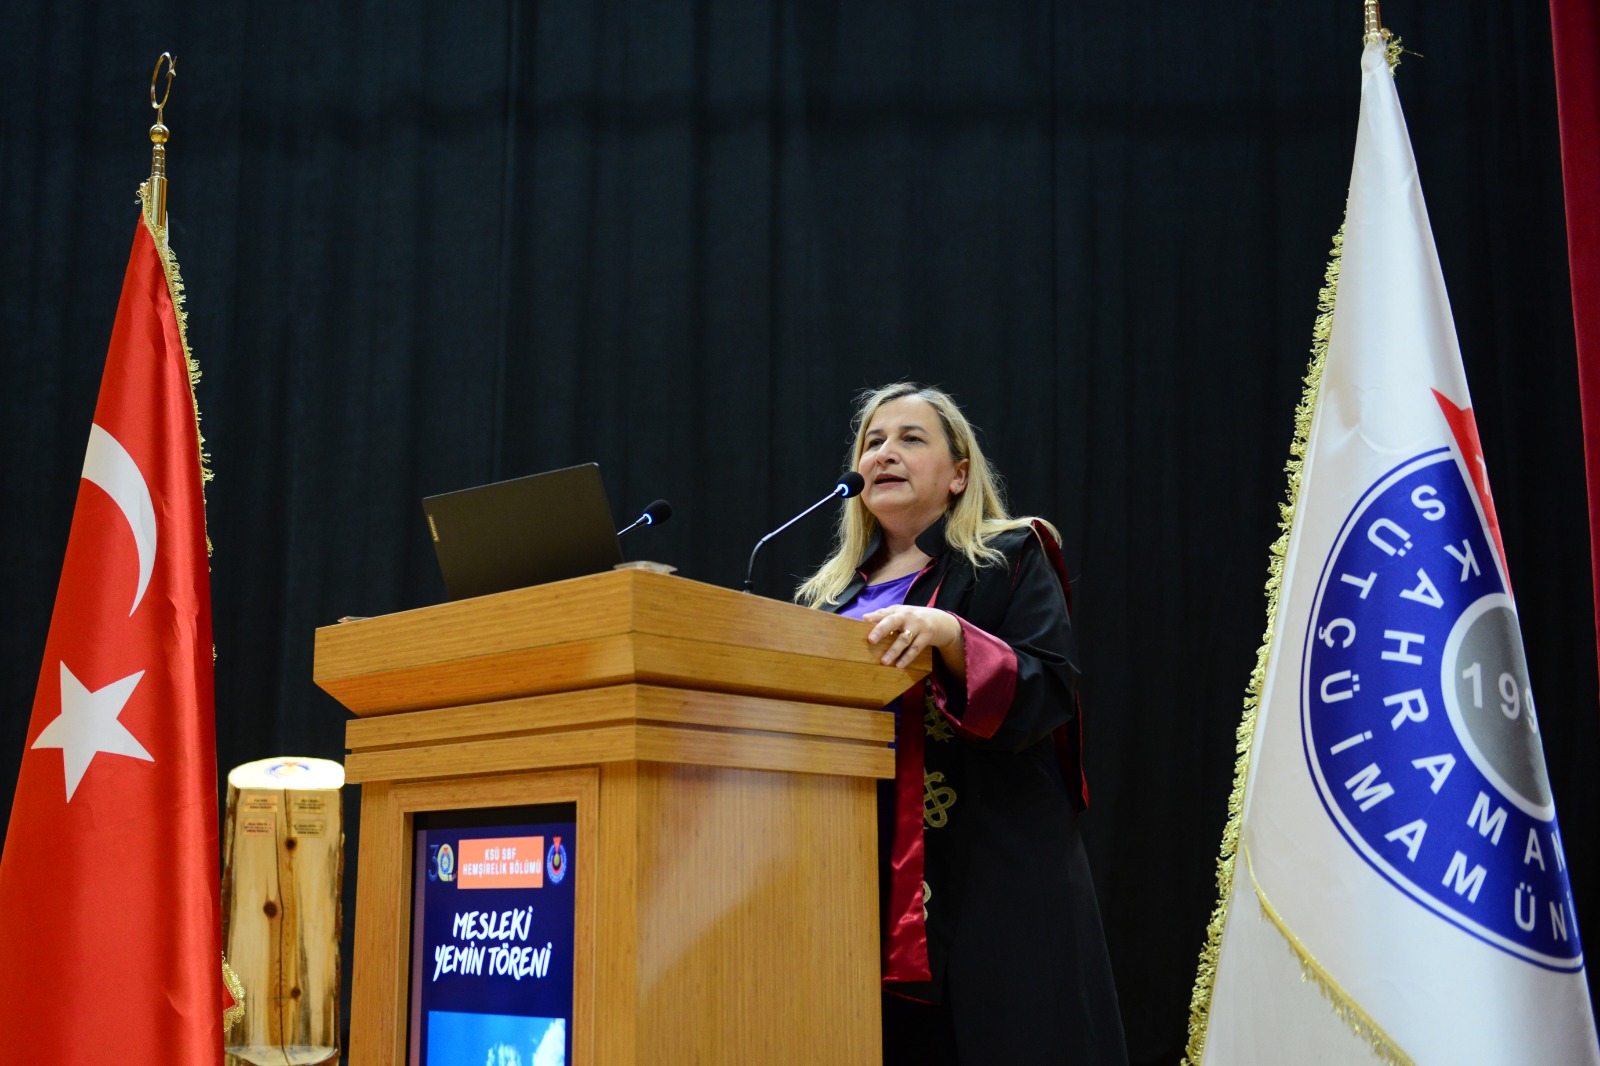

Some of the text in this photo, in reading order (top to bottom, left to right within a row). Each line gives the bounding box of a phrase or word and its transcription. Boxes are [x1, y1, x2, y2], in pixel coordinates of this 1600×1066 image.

[1329, 730, 1488, 904] İMAM
[462, 862, 507, 877] HEMŞİRELİK
[509, 860, 541, 874] BÖLÜMÜ
[485, 847, 516, 861] KSÜ SBF
[452, 905, 534, 942] MESLEKİ
[432, 940, 553, 982] YEMİN TÖRENİ
